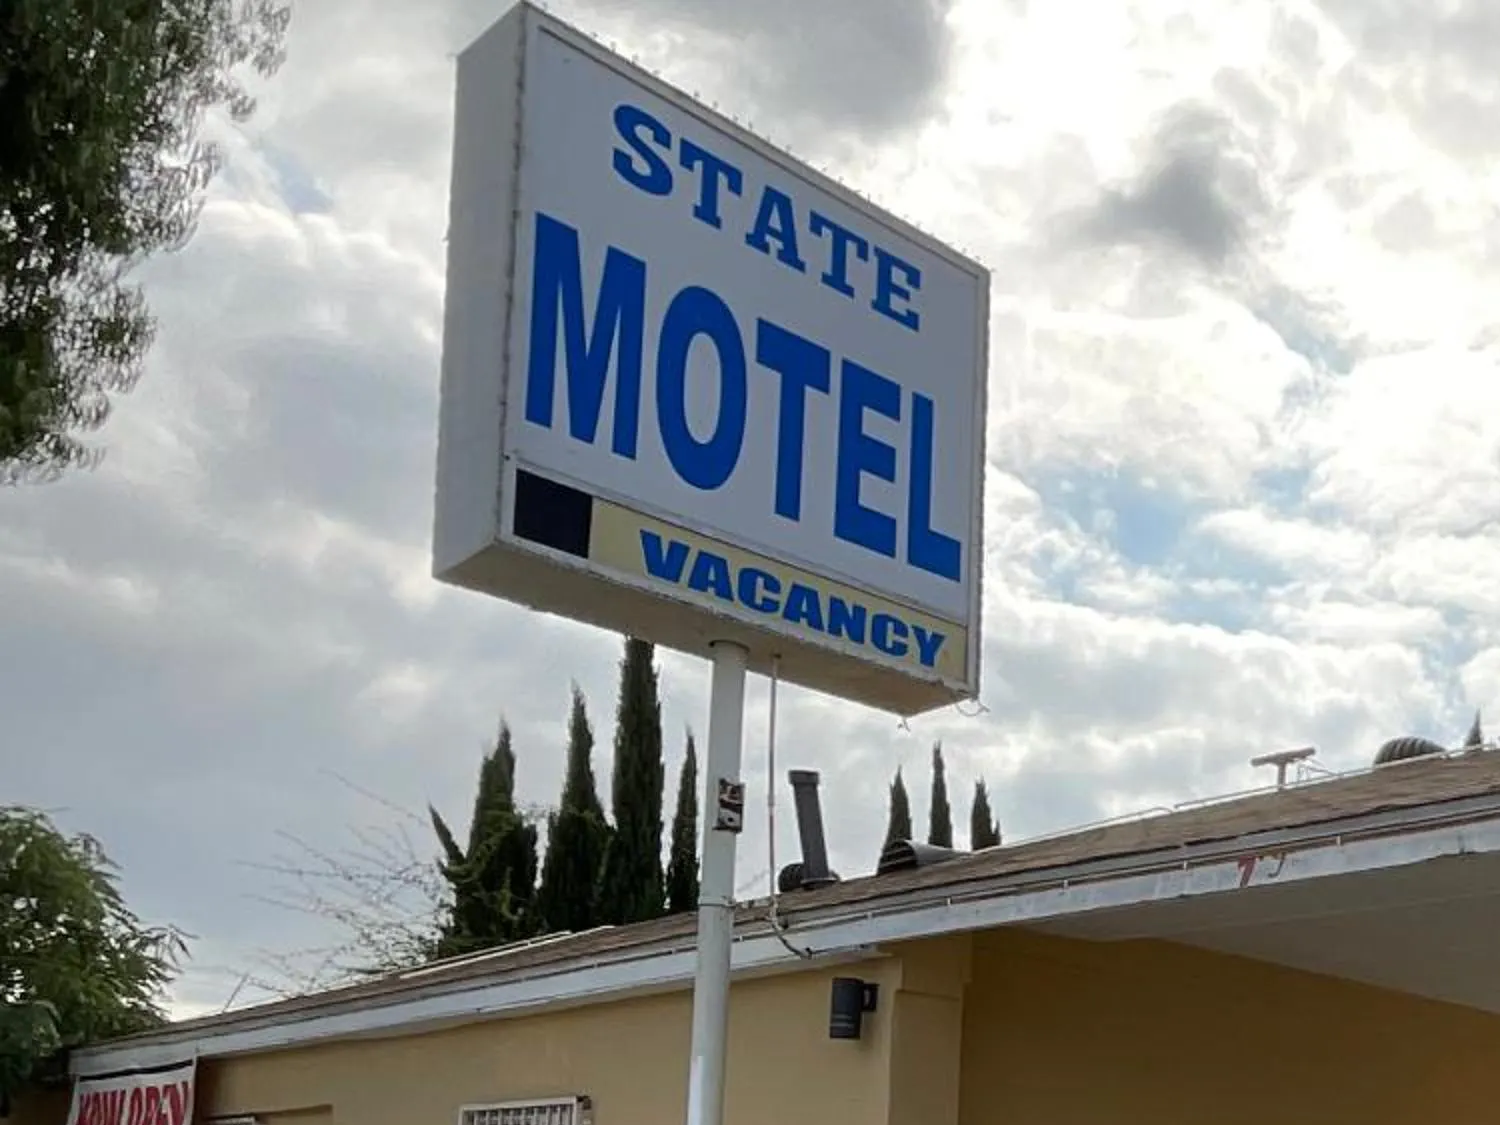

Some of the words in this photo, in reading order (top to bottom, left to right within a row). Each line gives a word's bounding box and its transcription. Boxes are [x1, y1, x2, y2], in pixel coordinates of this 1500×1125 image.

[612, 103, 922, 332] STATE
[524, 211, 962, 583] MOTEL
[639, 528, 947, 668] VACANCY
